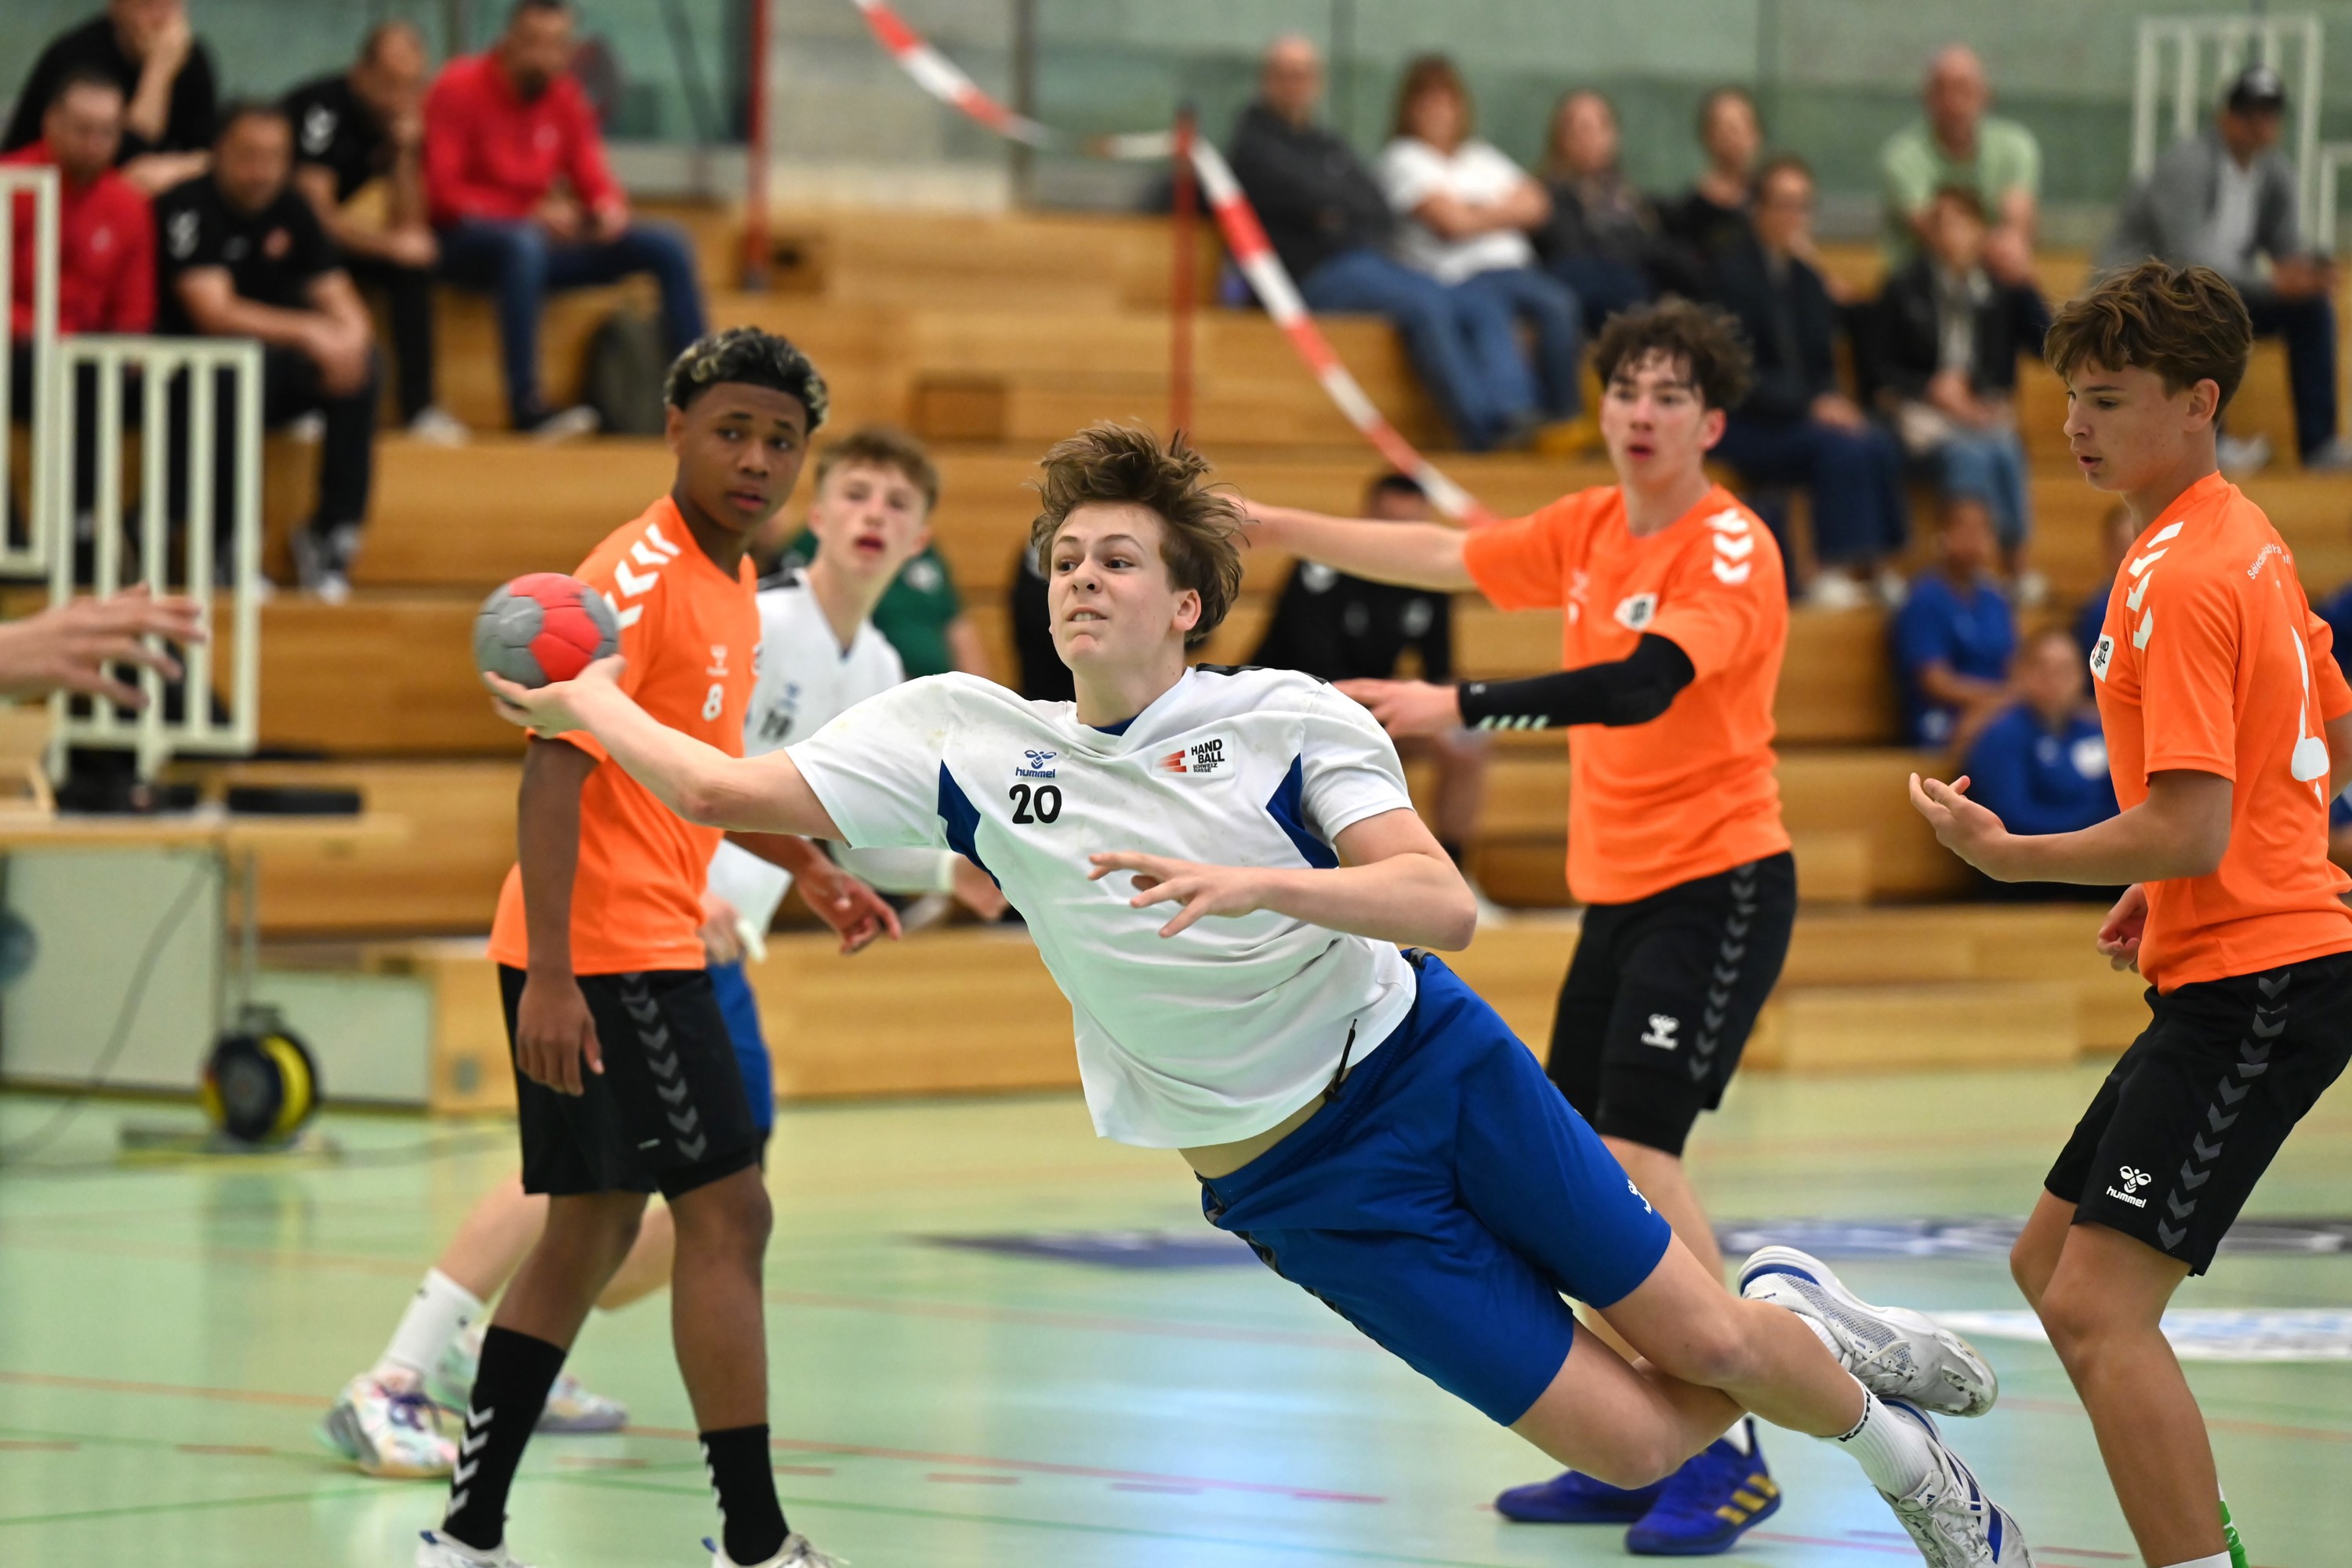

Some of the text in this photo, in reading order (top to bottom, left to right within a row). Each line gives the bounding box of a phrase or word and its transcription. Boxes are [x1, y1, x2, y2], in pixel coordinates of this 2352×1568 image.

[702, 683, 723, 720] 8
[1191, 739, 1222, 756] HAND
[1198, 750, 1225, 764] BALL
[1015, 767, 1055, 778] hummel
[1009, 784, 1062, 824] 20
[2107, 1185, 2147, 1208] hummel
